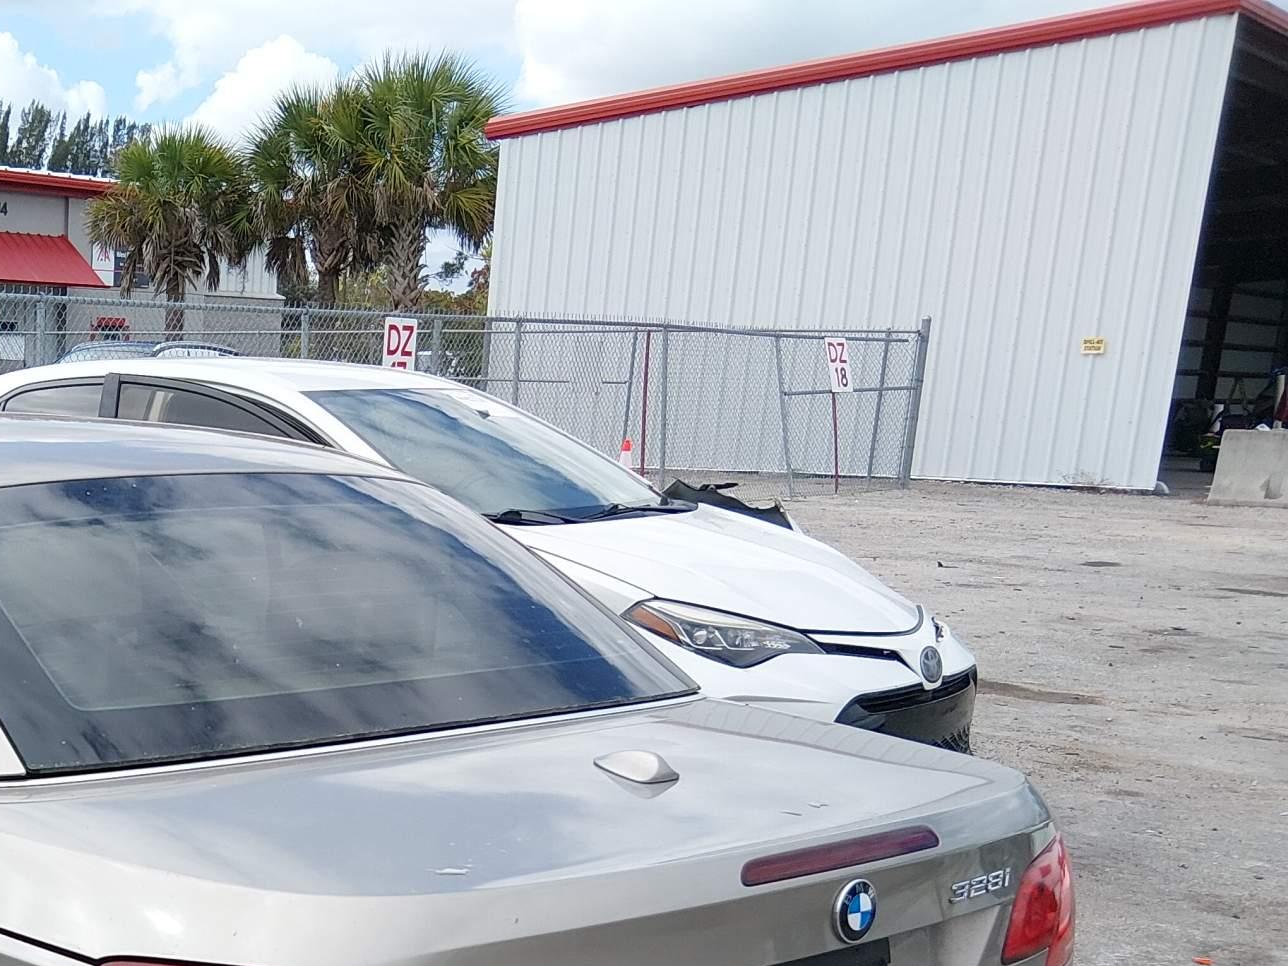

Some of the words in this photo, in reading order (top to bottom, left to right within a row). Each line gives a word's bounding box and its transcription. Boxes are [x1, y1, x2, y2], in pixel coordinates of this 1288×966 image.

[386, 324, 414, 357] DZ
[827, 341, 848, 364] DZ
[835, 367, 849, 388] 18
[949, 867, 1011, 905] 328i
